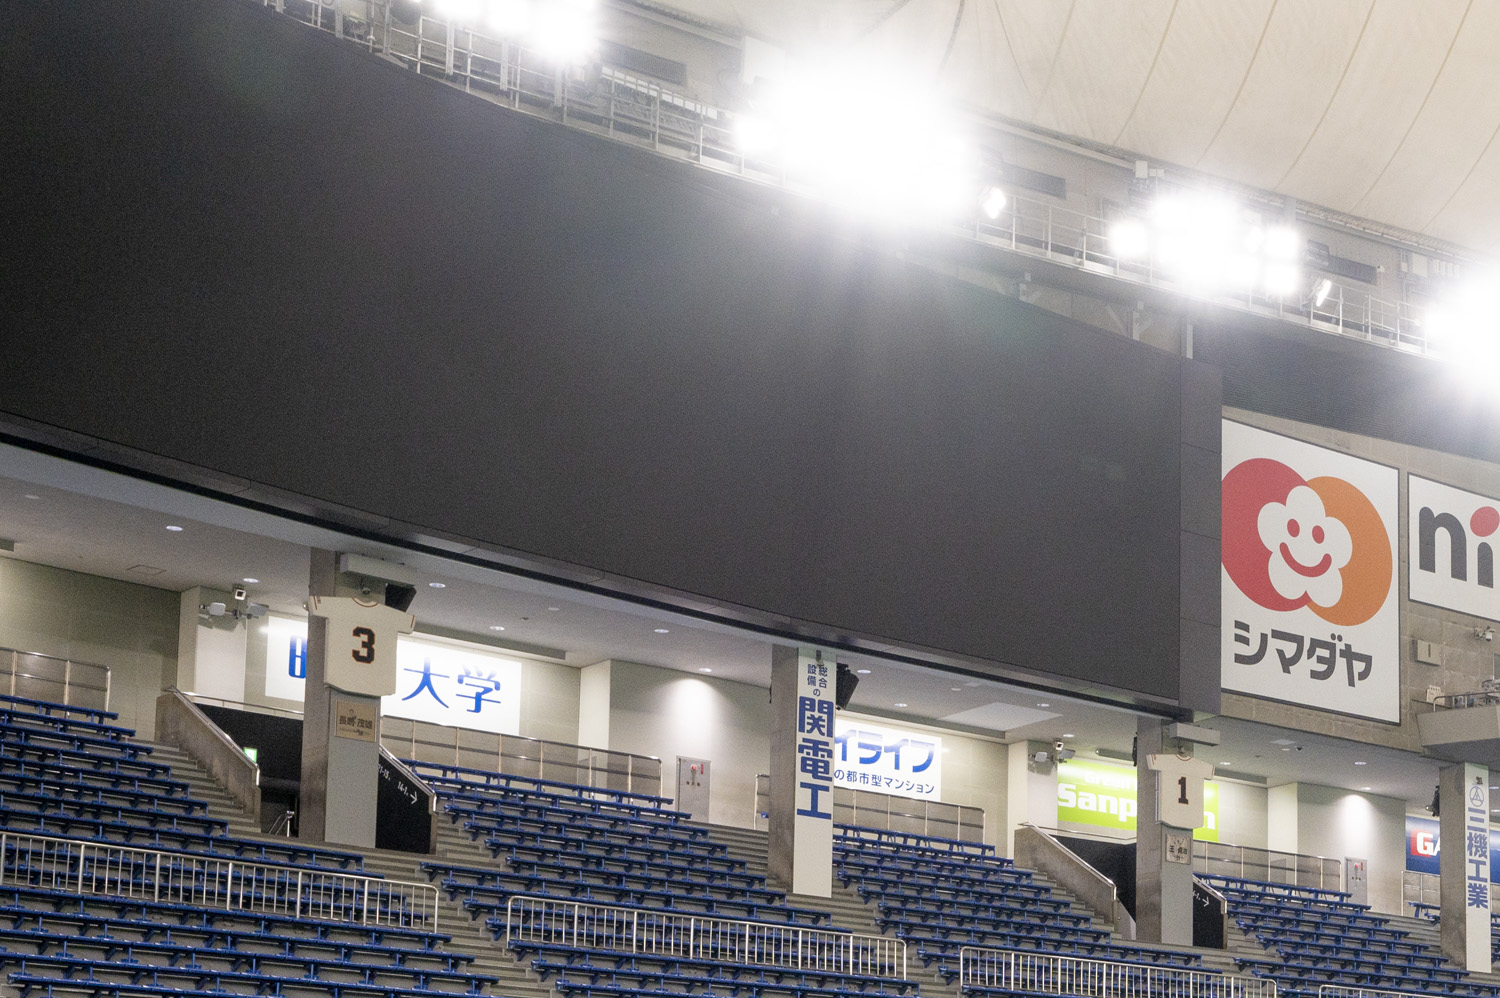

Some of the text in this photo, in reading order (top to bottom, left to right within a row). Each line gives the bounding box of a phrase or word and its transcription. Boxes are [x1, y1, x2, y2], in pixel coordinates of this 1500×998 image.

[352, 626, 376, 664] 3
[1233, 619, 1373, 687] シマダヤ
[797, 696, 834, 821] 関電工
[1178, 776, 1189, 805] 1
[1466, 806, 1489, 909] 三機工業
